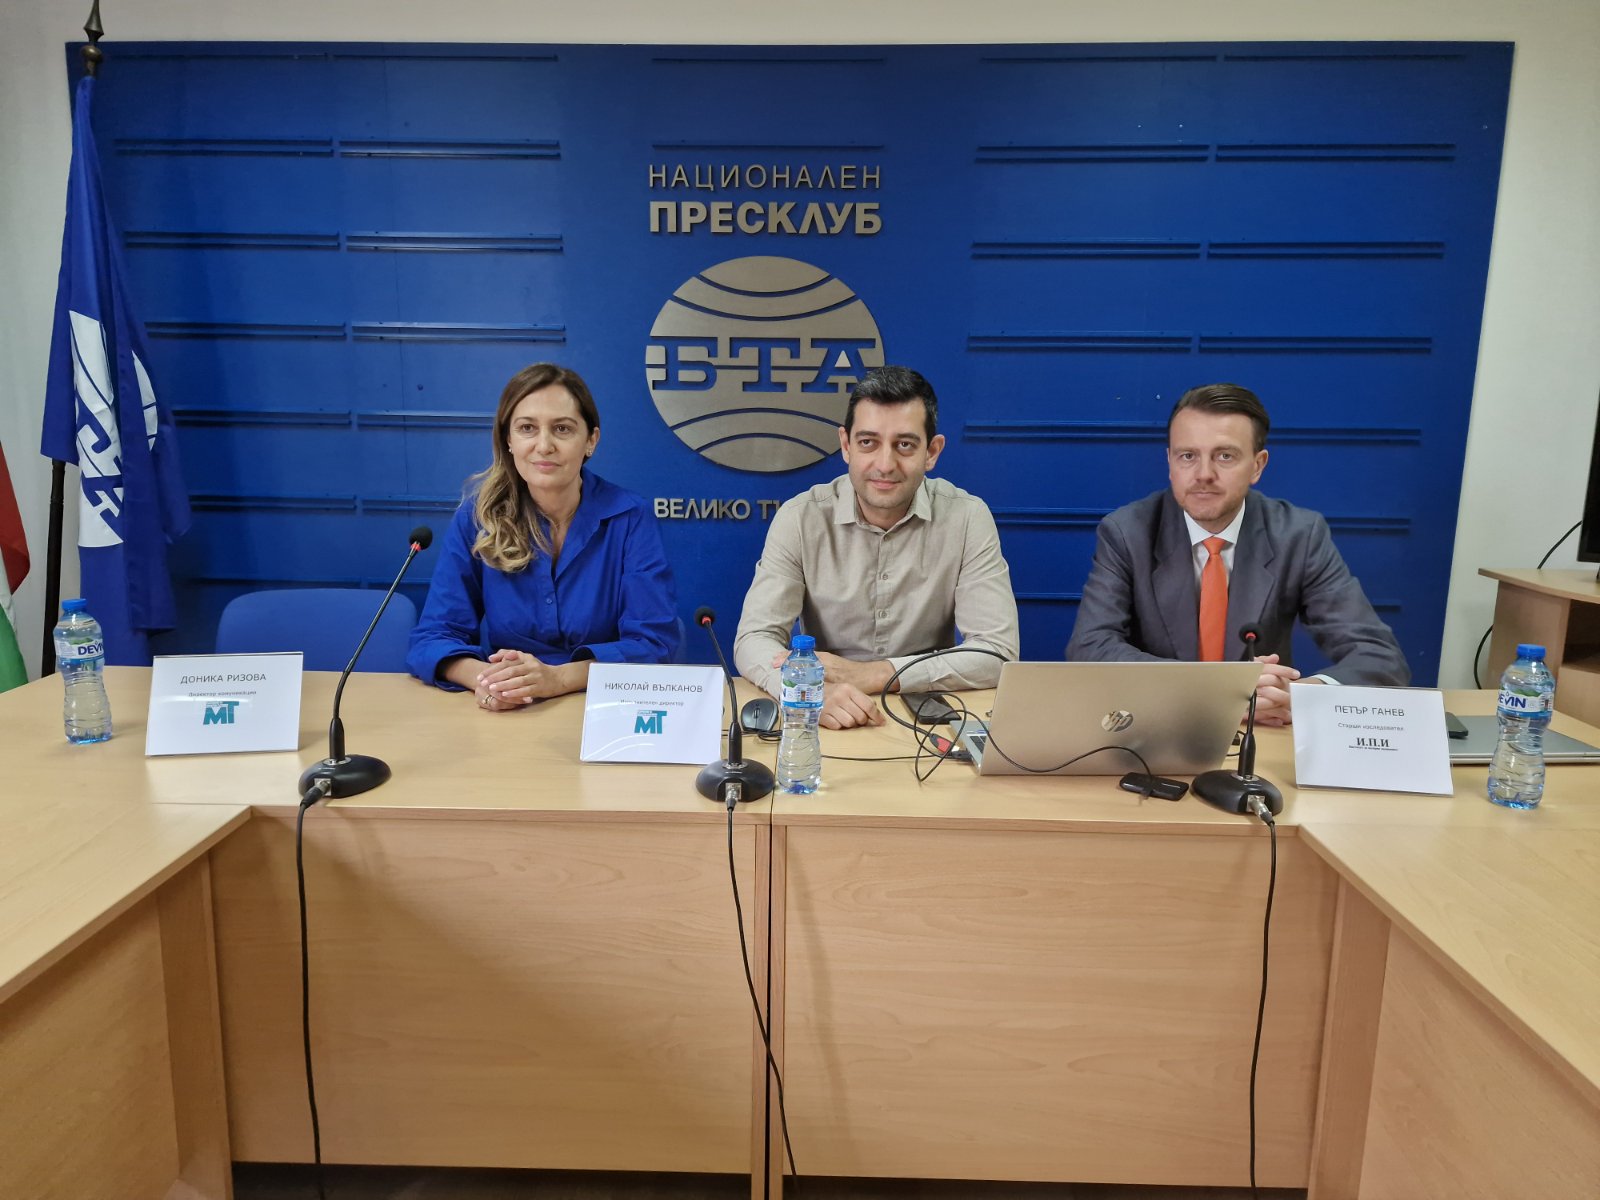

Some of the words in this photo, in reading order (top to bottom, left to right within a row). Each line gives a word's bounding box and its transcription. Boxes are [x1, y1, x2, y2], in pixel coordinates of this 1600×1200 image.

[649, 164, 881, 191] НАЦИОНАЛЕН
[650, 201, 883, 234] ПРЕСКЛУБ
[650, 336, 877, 393] БТА
[653, 497, 751, 520] ВЕЛИКО
[180, 674, 224, 685] ДОНИКА
[226, 672, 267, 683] РИЗОВА
[604, 681, 650, 692] НИКОЛАЙ
[652, 683, 703, 693] ВЪЛКАНОВ
[1334, 705, 1369, 715] ПЕТЪР
[1371, 707, 1405, 717] ГАНЕВ
[1356, 737, 1390, 748] И.П.И
